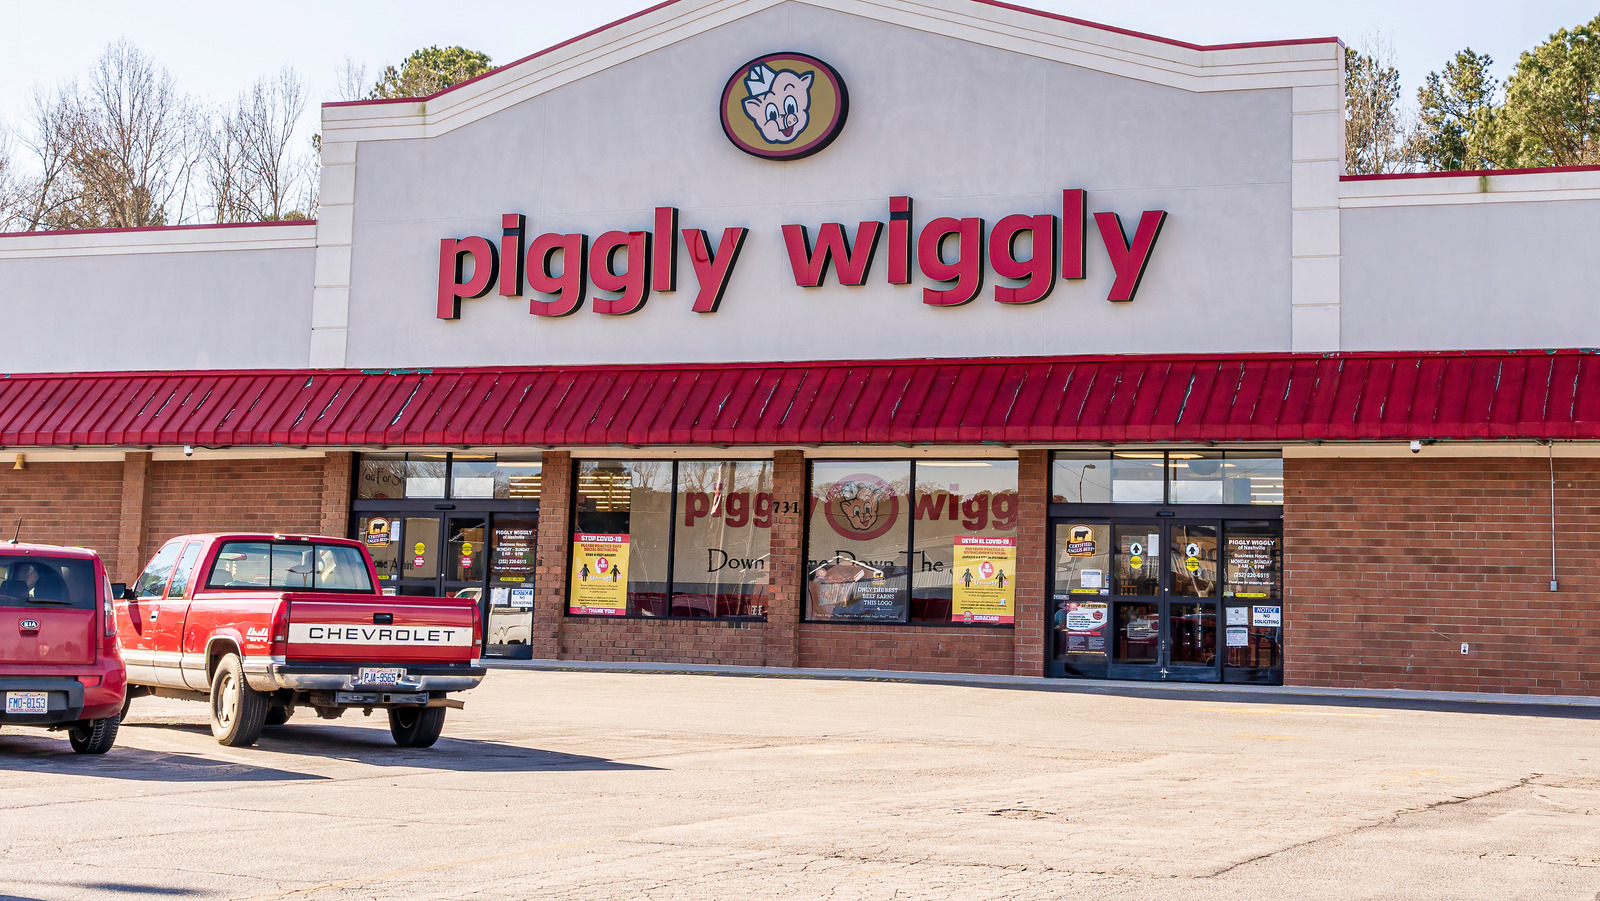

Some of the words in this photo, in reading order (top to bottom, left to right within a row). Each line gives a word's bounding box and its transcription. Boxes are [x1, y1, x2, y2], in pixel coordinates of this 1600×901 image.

[437, 205, 749, 321] piggly
[781, 188, 1168, 307] wiggly
[685, 483, 774, 529] pigg
[906, 484, 1019, 531] wigg
[773, 501, 800, 514] 731
[707, 548, 764, 572] Down
[309, 627, 455, 642] CHEVROLET
[364, 672, 396, 682] PJA-9565
